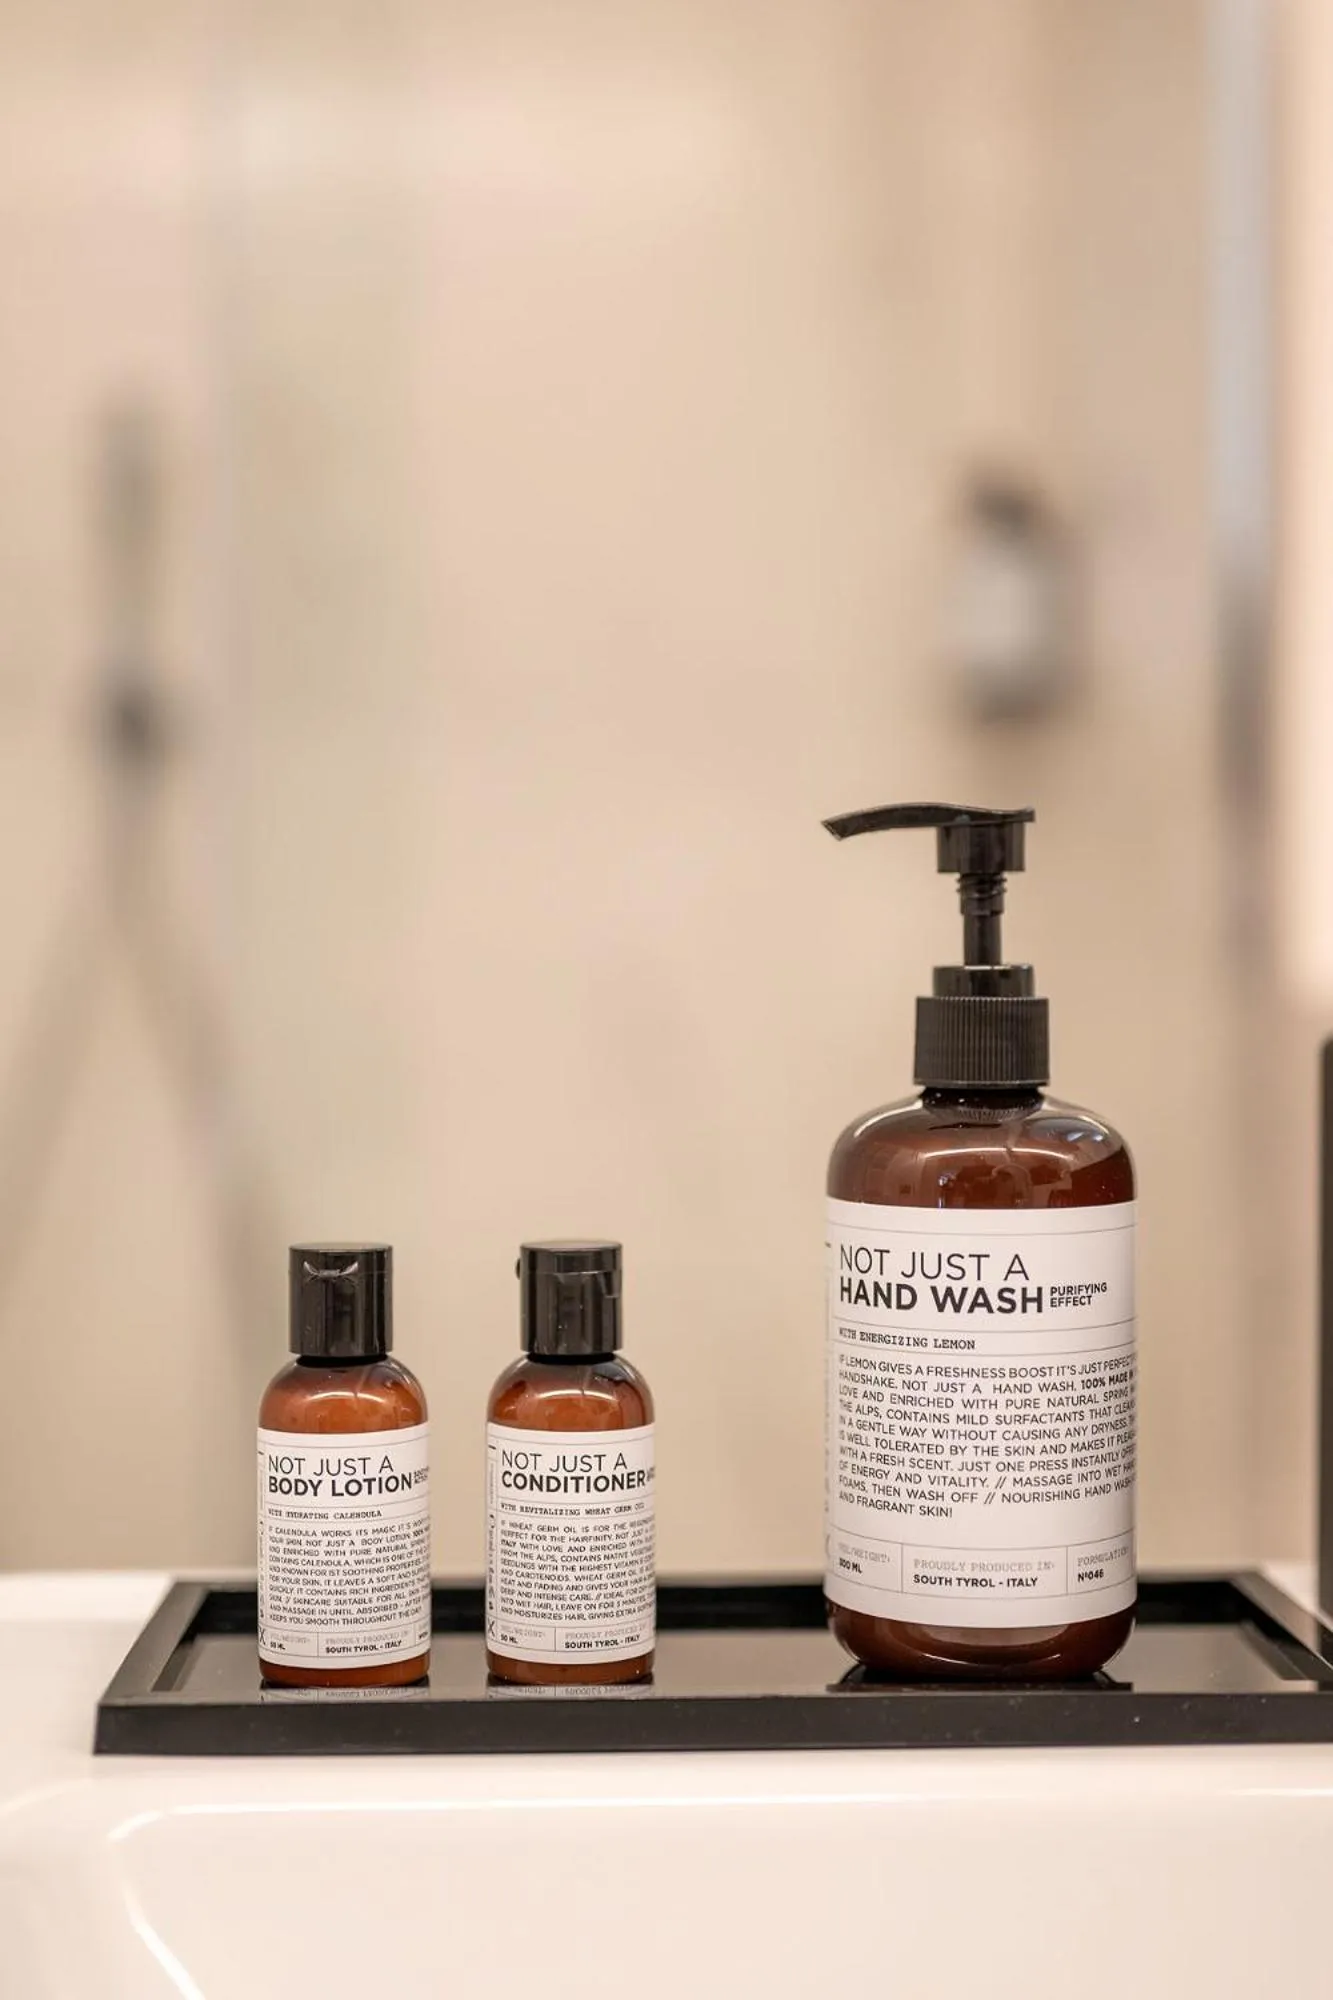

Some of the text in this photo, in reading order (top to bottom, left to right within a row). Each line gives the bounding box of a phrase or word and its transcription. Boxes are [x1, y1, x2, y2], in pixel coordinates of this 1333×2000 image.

[840, 1244, 1030, 1281] NOT JUST A
[840, 1276, 1043, 1314] HAND WASH
[1050, 1282, 1107, 1296] PURIFYING
[1050, 1295, 1092, 1308] EFFECT
[859, 1331, 928, 1348] ENERGIZING
[933, 1338, 976, 1350] LEMON
[846, 1357, 1102, 1379] LEMON GIVES A FRESHNESS BOOST IT'S JUST
[902, 1380, 928, 1391] NOT
[934, 1382, 966, 1393] JUST
[972, 1384, 982, 1394] A
[993, 1383, 1032, 1394] HAND
[1081, 1377, 1105, 1390] 100%
[840, 1384, 858, 1398] LOVE
[862, 1390, 884, 1402] AND
[890, 1393, 954, 1408] ENRICHED
[962, 1399, 998, 1409] WITH
[1006, 1399, 1040, 1410] PURE
[1047, 1393, 1099, 1408] NATURAL
[856, 1404, 882, 1419] ALPS,
[886, 1409, 950, 1424] CONTAINS
[956, 1414, 989, 1425] MILD
[995, 1410, 1085, 1425] SURFACTANTS
[1090, 1406, 1112, 1419] THAT
[856, 1420, 896, 1435] GENTLE
[900, 1425, 927, 1437] WAY
[932, 1428, 997, 1440] WITHOUT
[1002, 1429, 1060, 1440] CAUSING
[1065, 1425, 1088, 1438] ANY
[847, 1434, 1115, 1456] WELL TOLERATED BY THE SKIN AND MAKES IT
[268, 1454, 306, 1475] NOT
[313, 1457, 371, 1477] JUST
[379, 1455, 394, 1474] A
[502, 1450, 628, 1473] NOT JUST A
[860, 1451, 867, 1460] A
[870, 1452, 905, 1467] FRESH
[909, 1458, 954, 1471] SCENT.
[958, 1461, 991, 1472] JUST
[995, 1461, 1025, 1472] ONE
[1029, 1460, 1068, 1471] PRESS
[1071, 1450, 1119, 1469] INSTANTLY
[269, 1476, 323, 1497] BODY
[331, 1472, 412, 1497] LOTION
[502, 1469, 646, 1493] CONDITIONER
[851, 1463, 890, 1479] ENERGY
[895, 1472, 922, 1484] AND
[928, 1475, 989, 1488] VITALITY.
[1012, 1474, 1073, 1487] MASSAGE
[1078, 1470, 1101, 1483] INTO
[1105, 1464, 1121, 1478] WET
[872, 1483, 901, 1497] THEN
[906, 1489, 945, 1501] WASH
[951, 1492, 979, 1503] OFF
[1002, 1489, 1080, 1503] NOURISHING
[1085, 1483, 1111, 1498] HAND
[840, 1491, 952, 1518] AND FRAGRANT SKIN!
[852, 1562, 862, 1574] ML
[971, 1562, 1033, 1573] PRODUCED
[913, 1574, 952, 1587] SOUTH
[956, 1577, 995, 1588] TYROL
[1007, 1577, 1038, 1588] ITALY
[326, 1646, 352, 1654] SOUTH
[354, 1644, 378, 1653] TYROL
[595, 1640, 618, 1648] TYROL
